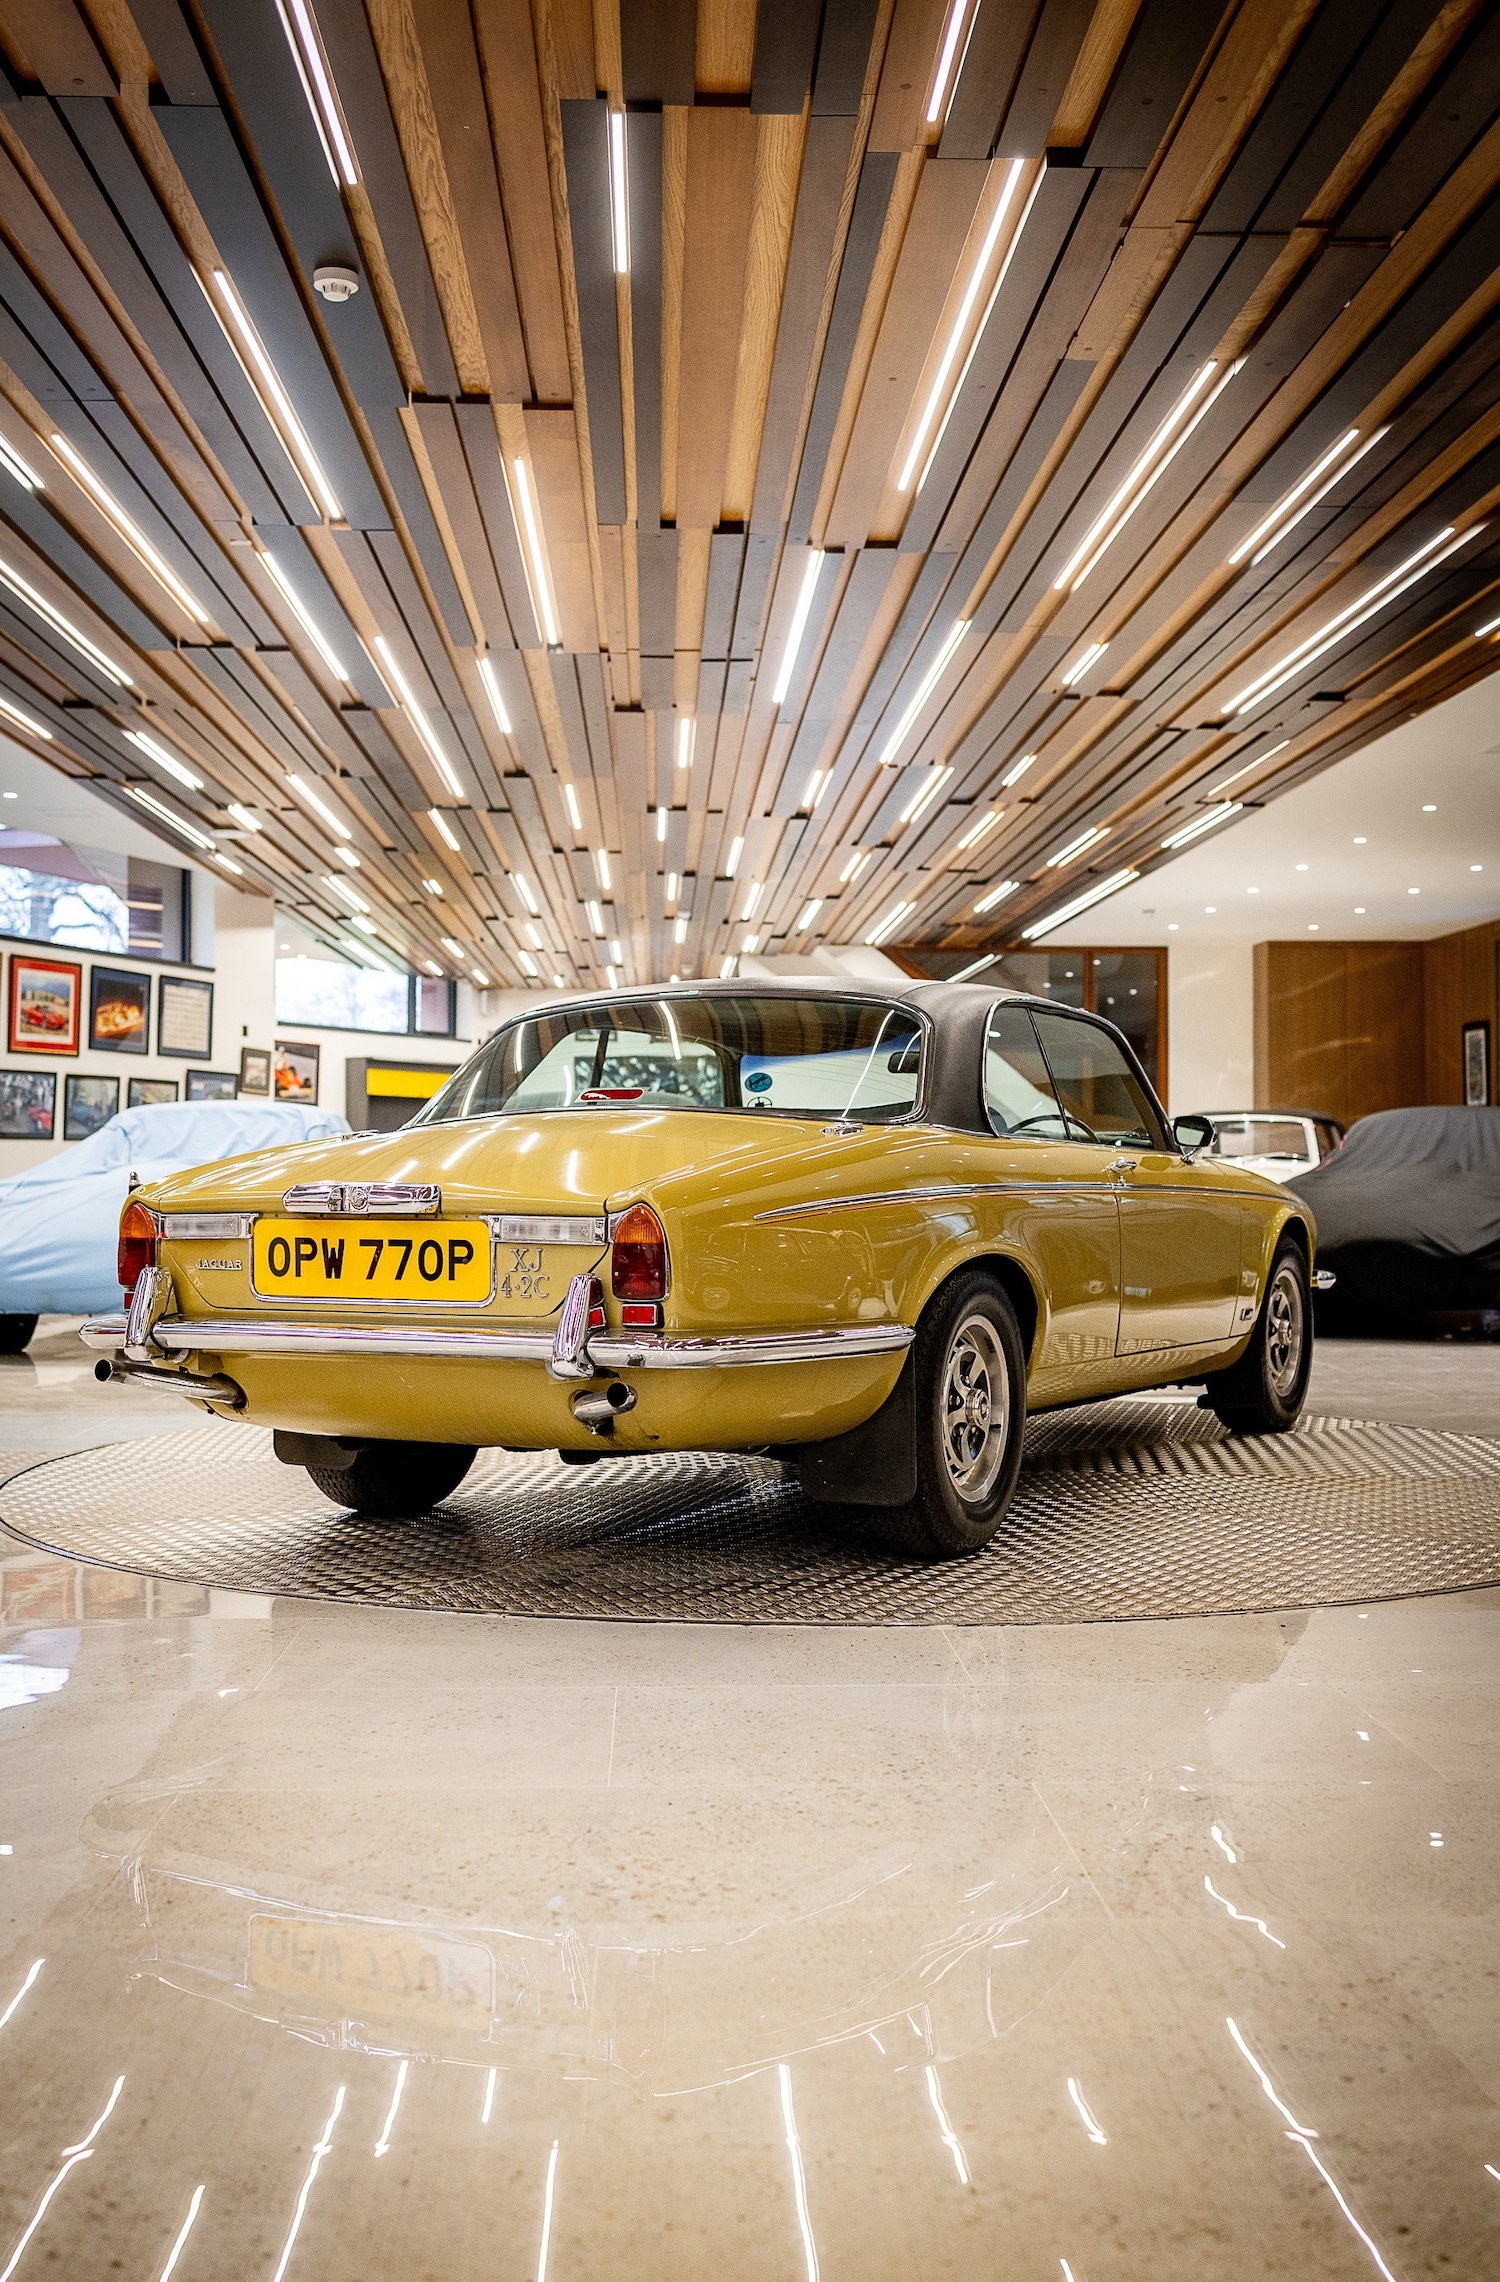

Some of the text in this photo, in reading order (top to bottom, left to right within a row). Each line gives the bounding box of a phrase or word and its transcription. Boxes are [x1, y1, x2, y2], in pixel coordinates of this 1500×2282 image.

[196, 1259, 243, 1270] JAGUAR
[268, 1237, 474, 1282] OPW 770P
[510, 1248, 543, 1272] XJ
